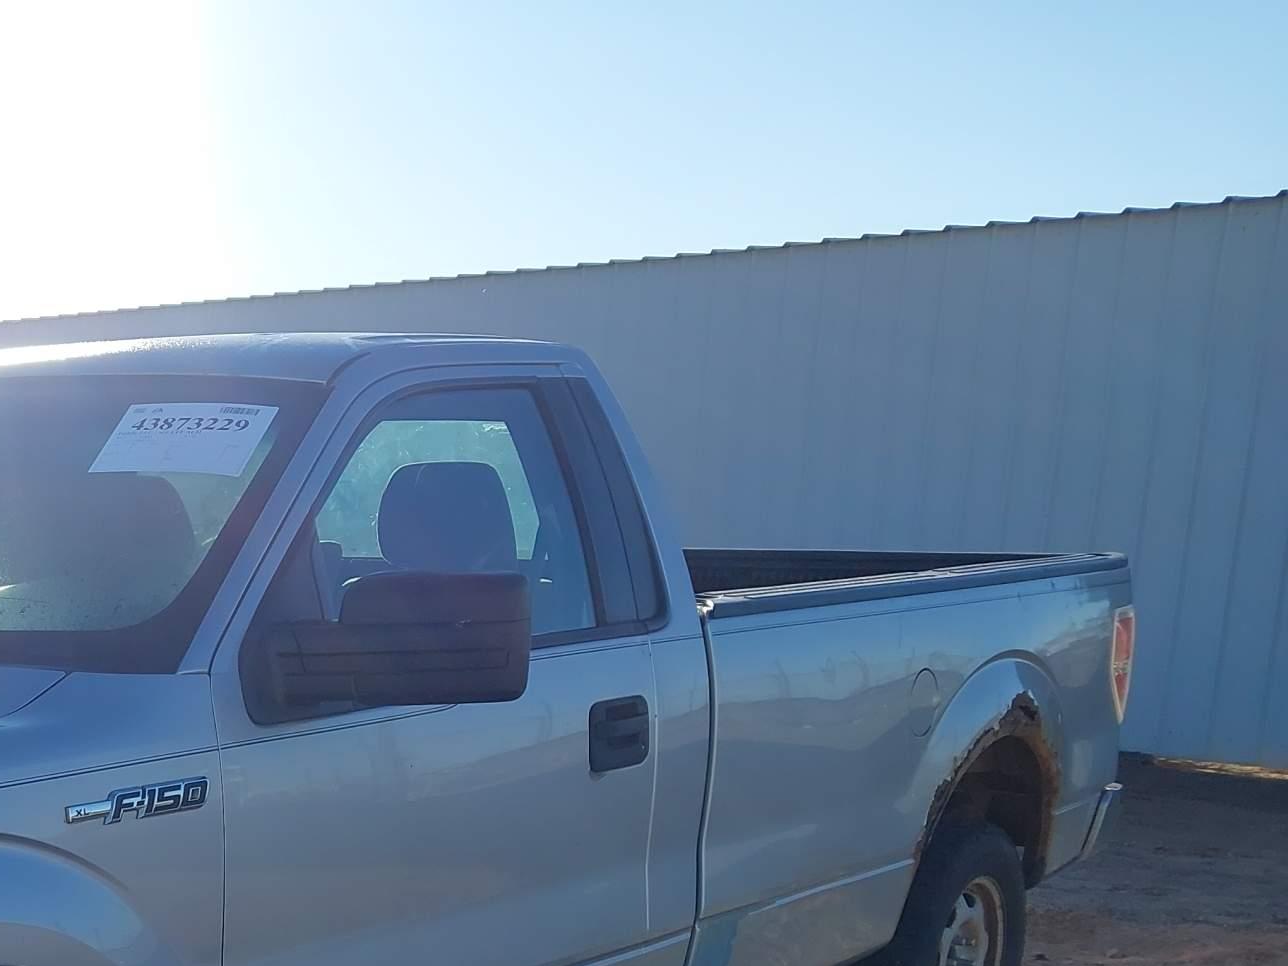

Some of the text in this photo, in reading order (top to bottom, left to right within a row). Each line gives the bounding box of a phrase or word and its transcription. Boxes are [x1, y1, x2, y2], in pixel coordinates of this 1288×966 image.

[130, 417, 250, 432] 43873229
[75, 777, 209, 824] XL F-150
